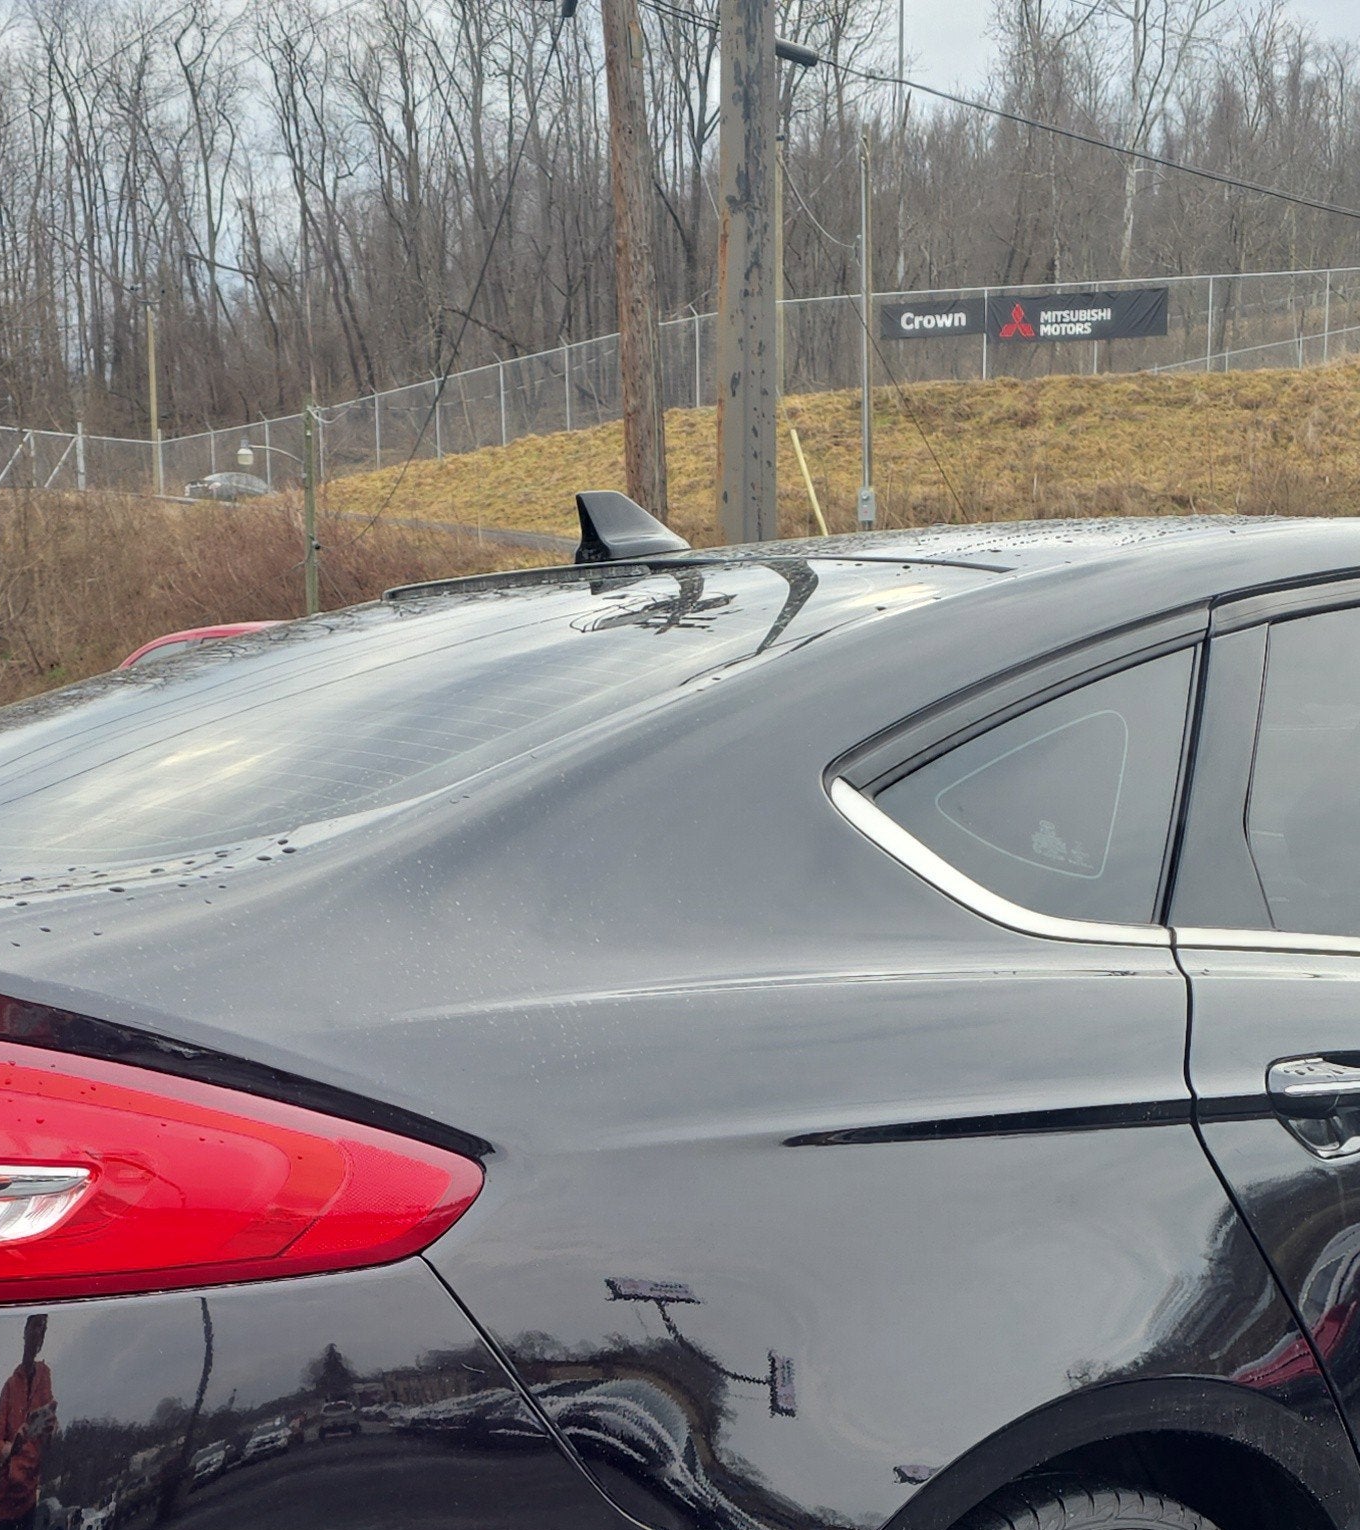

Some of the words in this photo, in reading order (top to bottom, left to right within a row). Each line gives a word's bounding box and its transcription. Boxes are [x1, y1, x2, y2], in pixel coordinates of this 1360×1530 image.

[900, 311, 967, 330] Crown
[1039, 307, 1112, 324] MITSUBISHI
[1039, 322, 1092, 337] MOTORS
